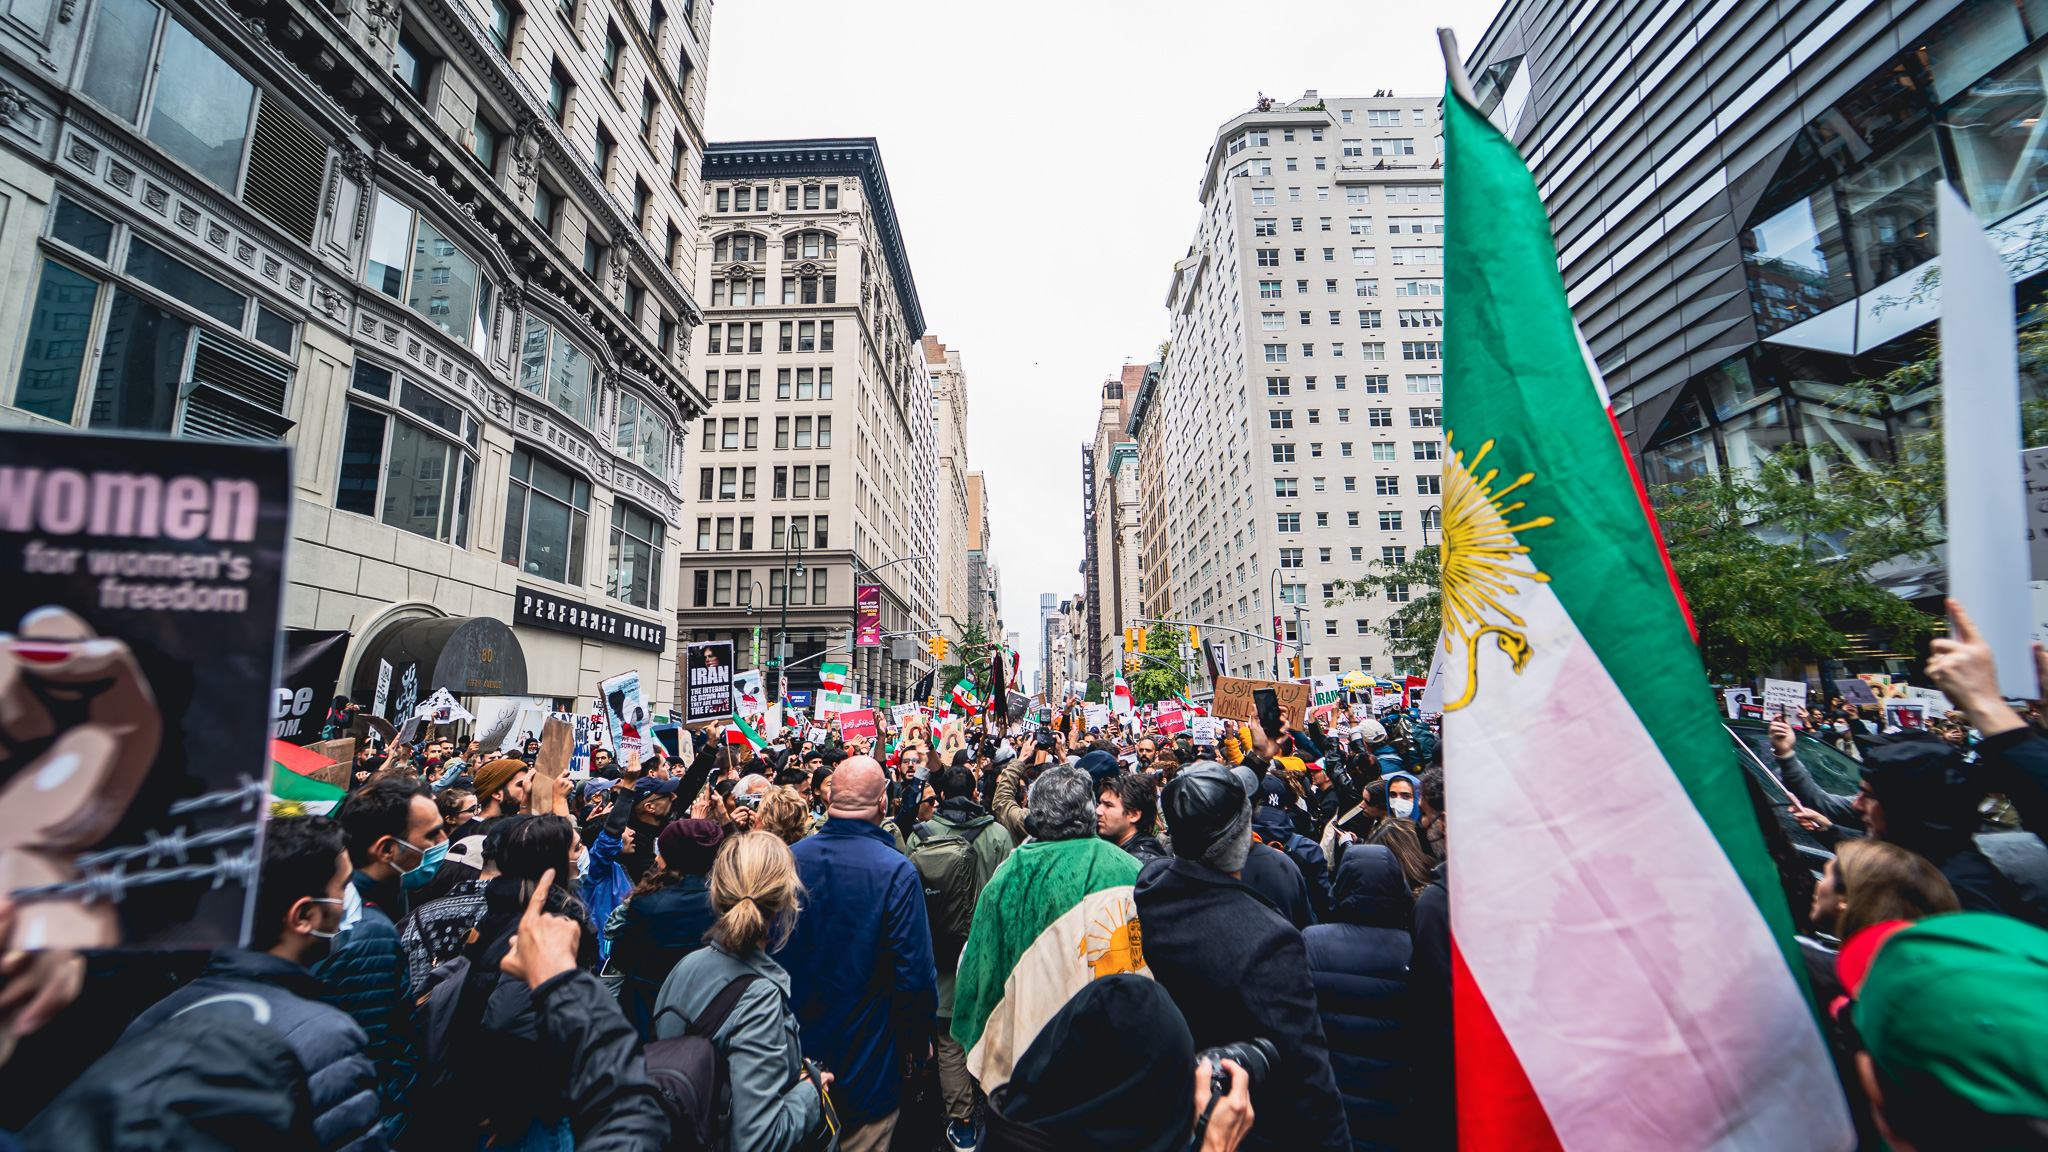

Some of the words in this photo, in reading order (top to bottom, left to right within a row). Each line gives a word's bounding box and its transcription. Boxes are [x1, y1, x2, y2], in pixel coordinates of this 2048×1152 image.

[0, 466, 259, 542] women
[24, 540, 82, 574] for
[88, 550, 251, 580] women's
[98, 576, 248, 612] freedom
[523, 596, 616, 634] PERFORMIX
[624, 621, 661, 645] HOUSE
[481, 648, 493, 663] 80
[691, 665, 729, 686] IRAN
[467, 679, 481, 689] FIFTH
[483, 680, 501, 690] AVENUE
[691, 687, 702, 695] THE
[703, 685, 730, 694] INTERNET
[1223, 681, 1258, 699] آزادی
[698, 693, 716, 701] DOWN
[1281, 687, 1300, 704] زن
[1315, 690, 1339, 706] IRAN
[691, 706, 704, 715] THE
